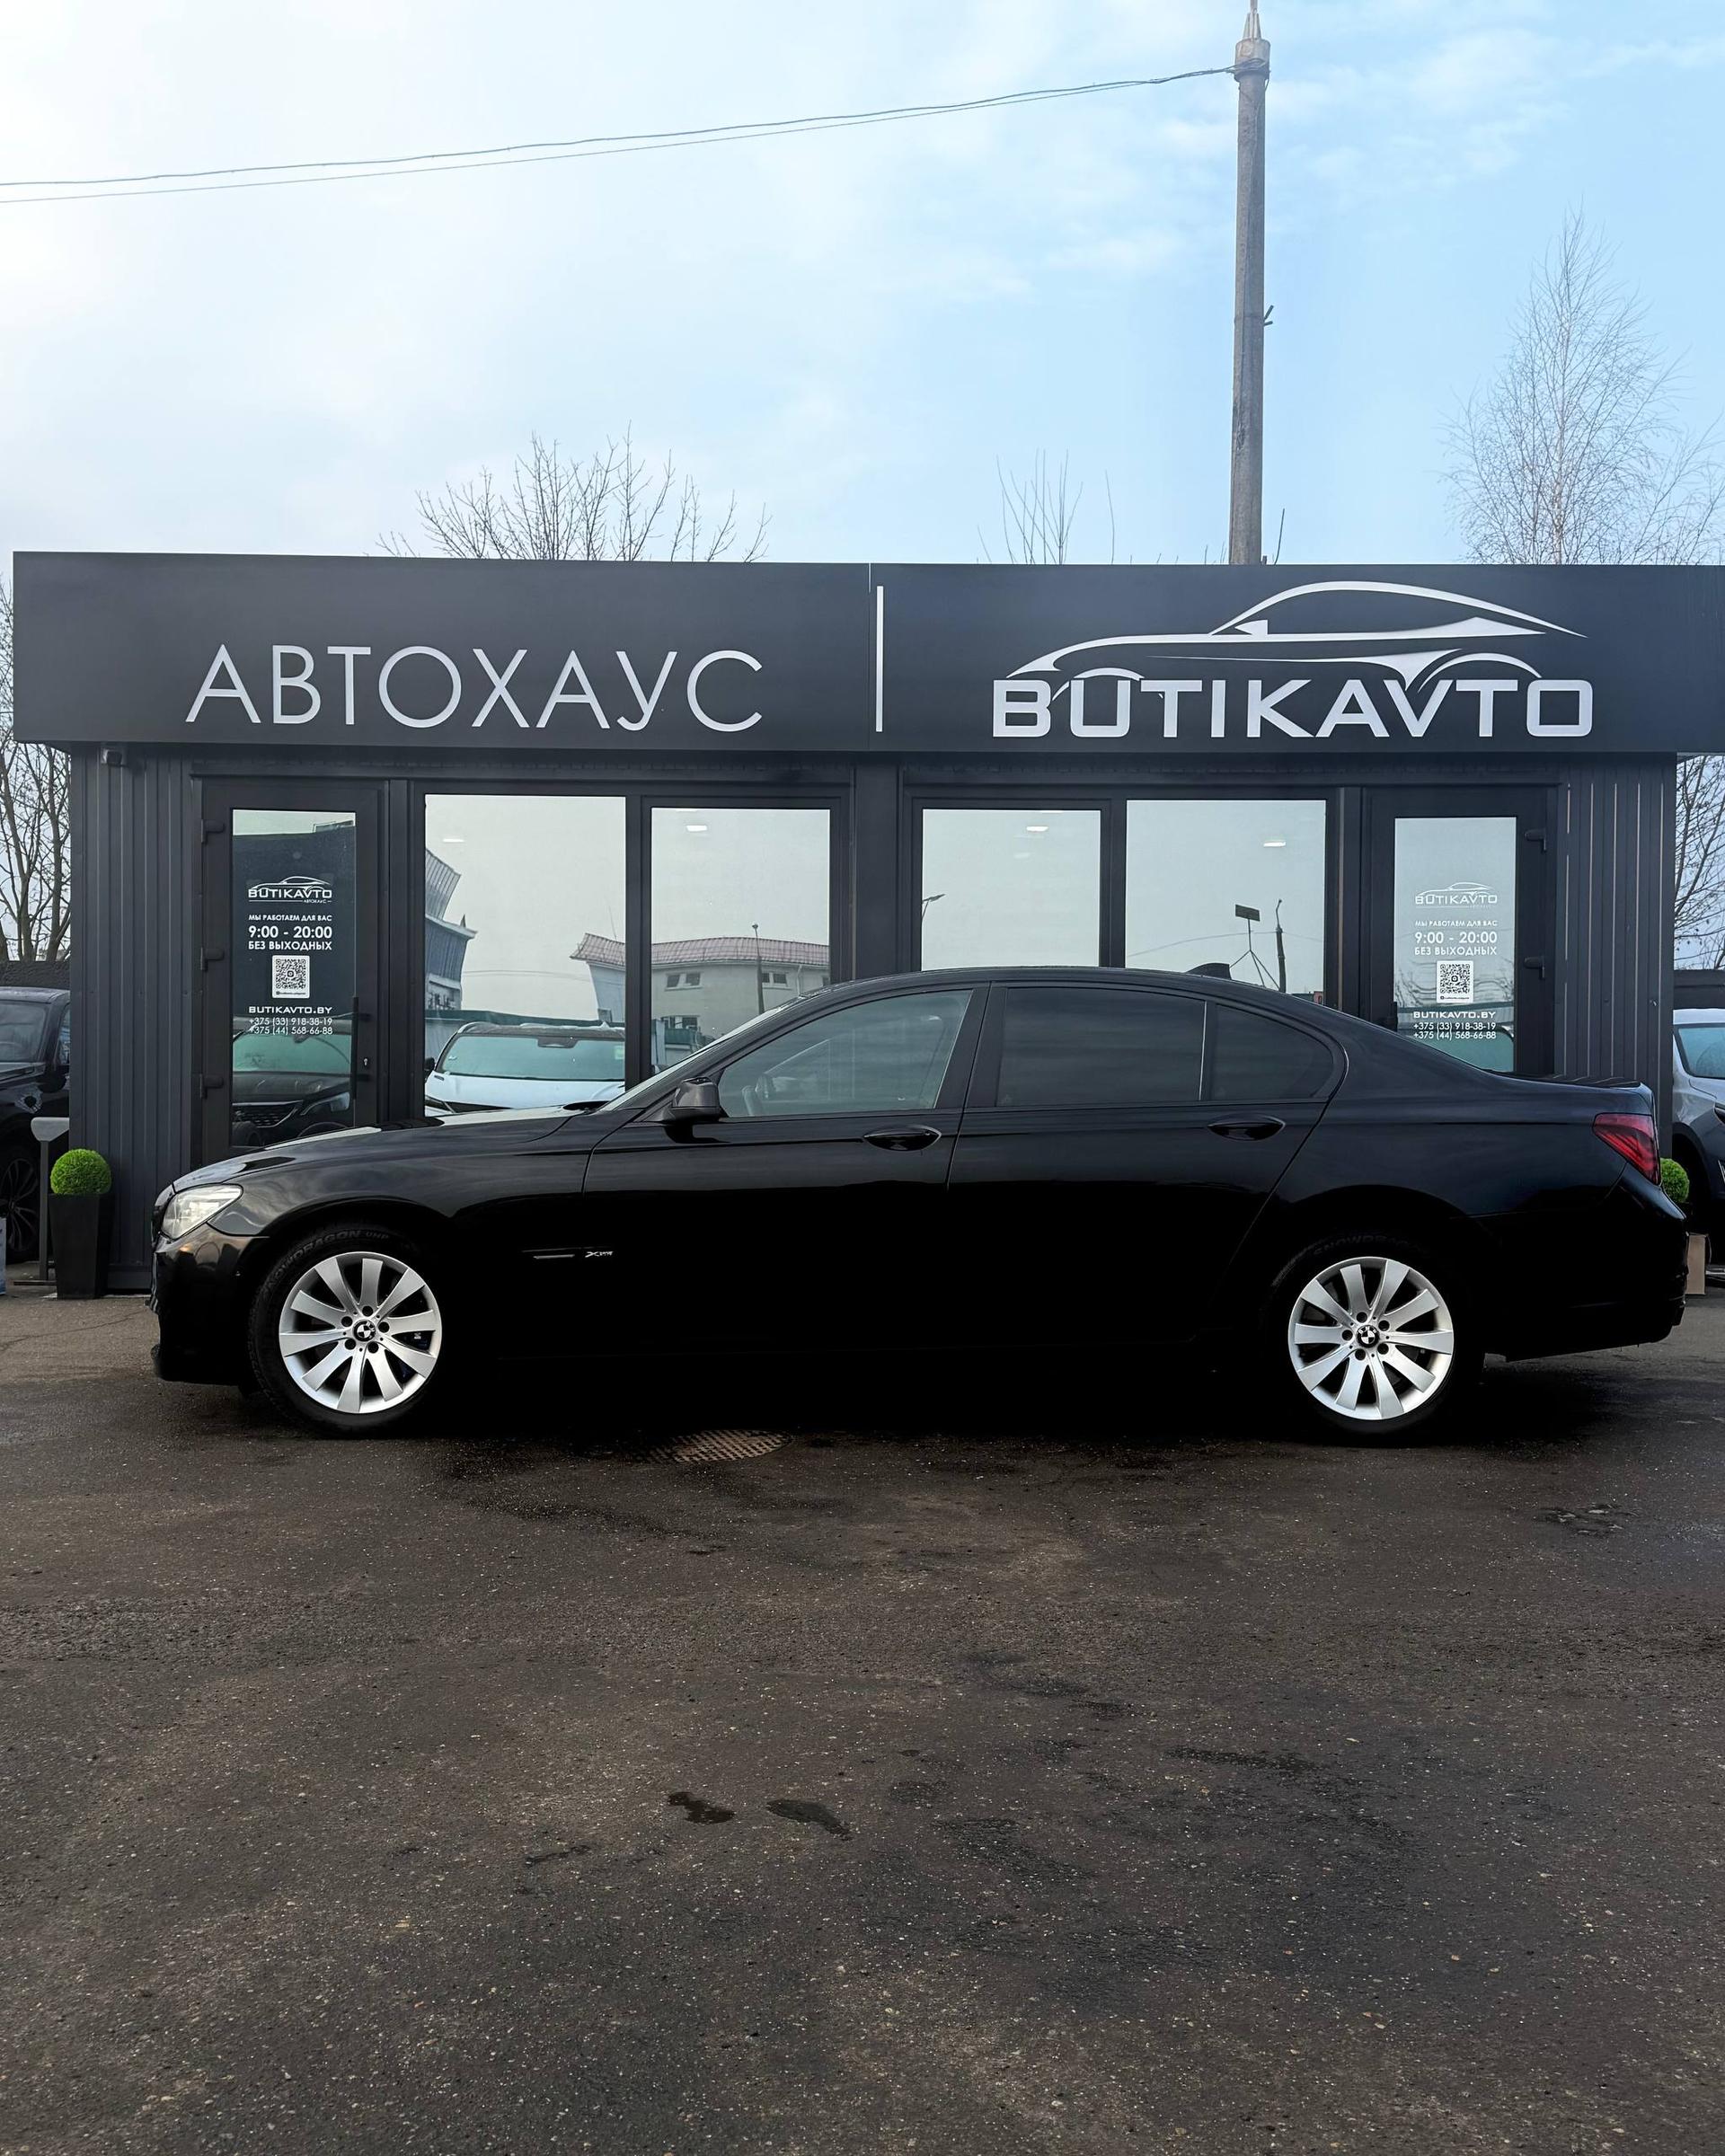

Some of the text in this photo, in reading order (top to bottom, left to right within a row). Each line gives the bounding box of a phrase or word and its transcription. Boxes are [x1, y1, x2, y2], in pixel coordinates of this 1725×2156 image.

[185, 643, 763, 732] АВТОХАУС
[993, 678, 1593, 738] BUTIKAVTO
[248, 888, 332, 898] BUTIKAVTO
[1415, 895, 1498, 905] BUTIKAVTO
[248, 925, 279, 938] 9:00
[293, 926, 332, 939] 20:00
[1415, 931, 1444, 943] 9:00
[1459, 931, 1498, 943] 20:00
[248, 941, 332, 951] БЕЗ ВЫХОДНЫХ
[1415, 946, 1497, 956] БЕЗ ВЫХОДНЫХ
[249, 1006, 332, 1014] BUTIKAVTO.BY
[249, 1017, 332, 1026] +375 (33) 918-38-19
[1413, 1022, 1497, 1031] +375 (33) 918-38-19
[272, 1026, 288, 1035] (44)
[291, 1027, 333, 1035] 568-66-88
[1413, 1030, 1497, 1040] +375 (44) 568-66-88
